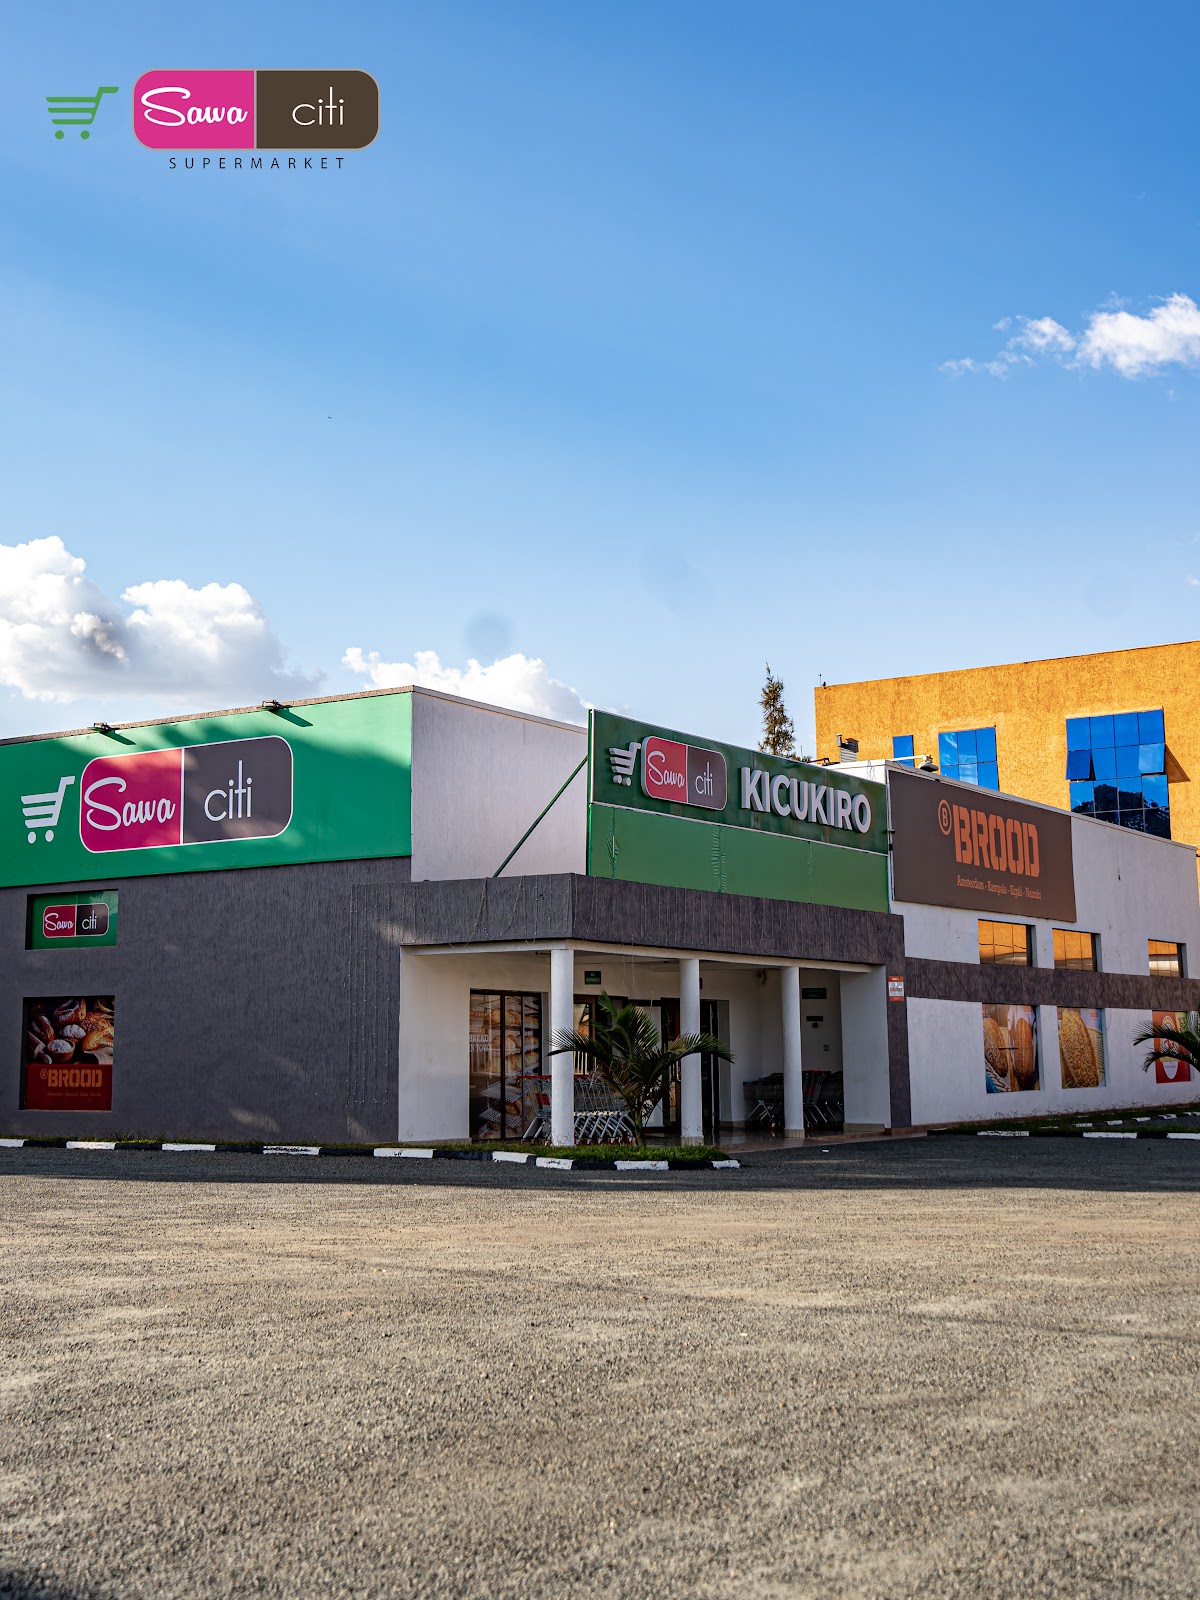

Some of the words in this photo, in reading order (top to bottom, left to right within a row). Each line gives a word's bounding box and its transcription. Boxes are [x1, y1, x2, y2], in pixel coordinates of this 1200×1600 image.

[84, 776, 176, 831] Sawa
[204, 759, 253, 822] citi
[646, 750, 685, 788] Sawa
[695, 761, 713, 796] citi
[740, 766, 872, 834] KICUKIRO
[952, 804, 1040, 878] BROOD
[957, 874, 985, 890] Amsterdam
[988, 880, 1007, 895] Kampala
[44, 912, 75, 931] Sawa
[81, 909, 97, 930] citi
[47, 1068, 103, 1088] BROOD
